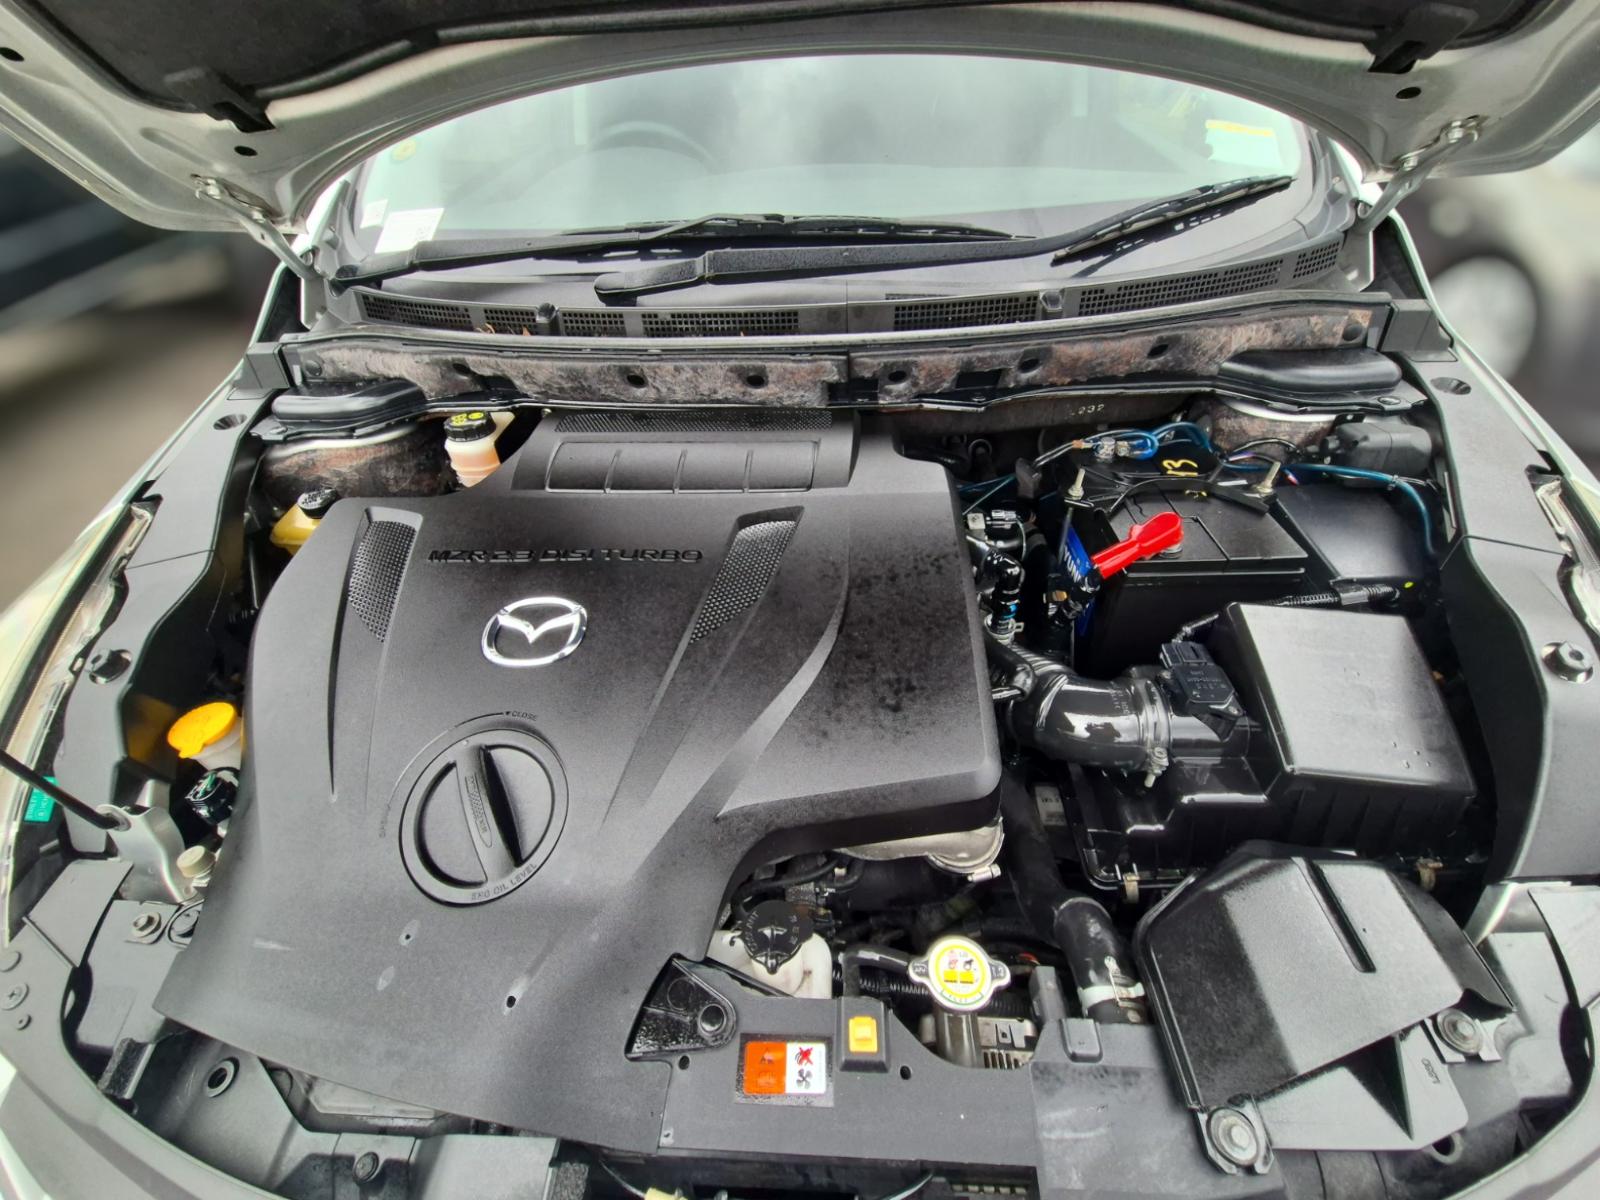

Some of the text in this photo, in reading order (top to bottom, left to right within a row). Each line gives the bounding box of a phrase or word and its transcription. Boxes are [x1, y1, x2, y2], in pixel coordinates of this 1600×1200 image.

[428, 550, 487, 563] MZR
[539, 550, 595, 563] DISI
[599, 549, 703, 563] TURBO
[511, 710, 537, 722] CLOSE
[493, 883, 509, 895] OIL
[510, 863, 537, 886] LEVEL
